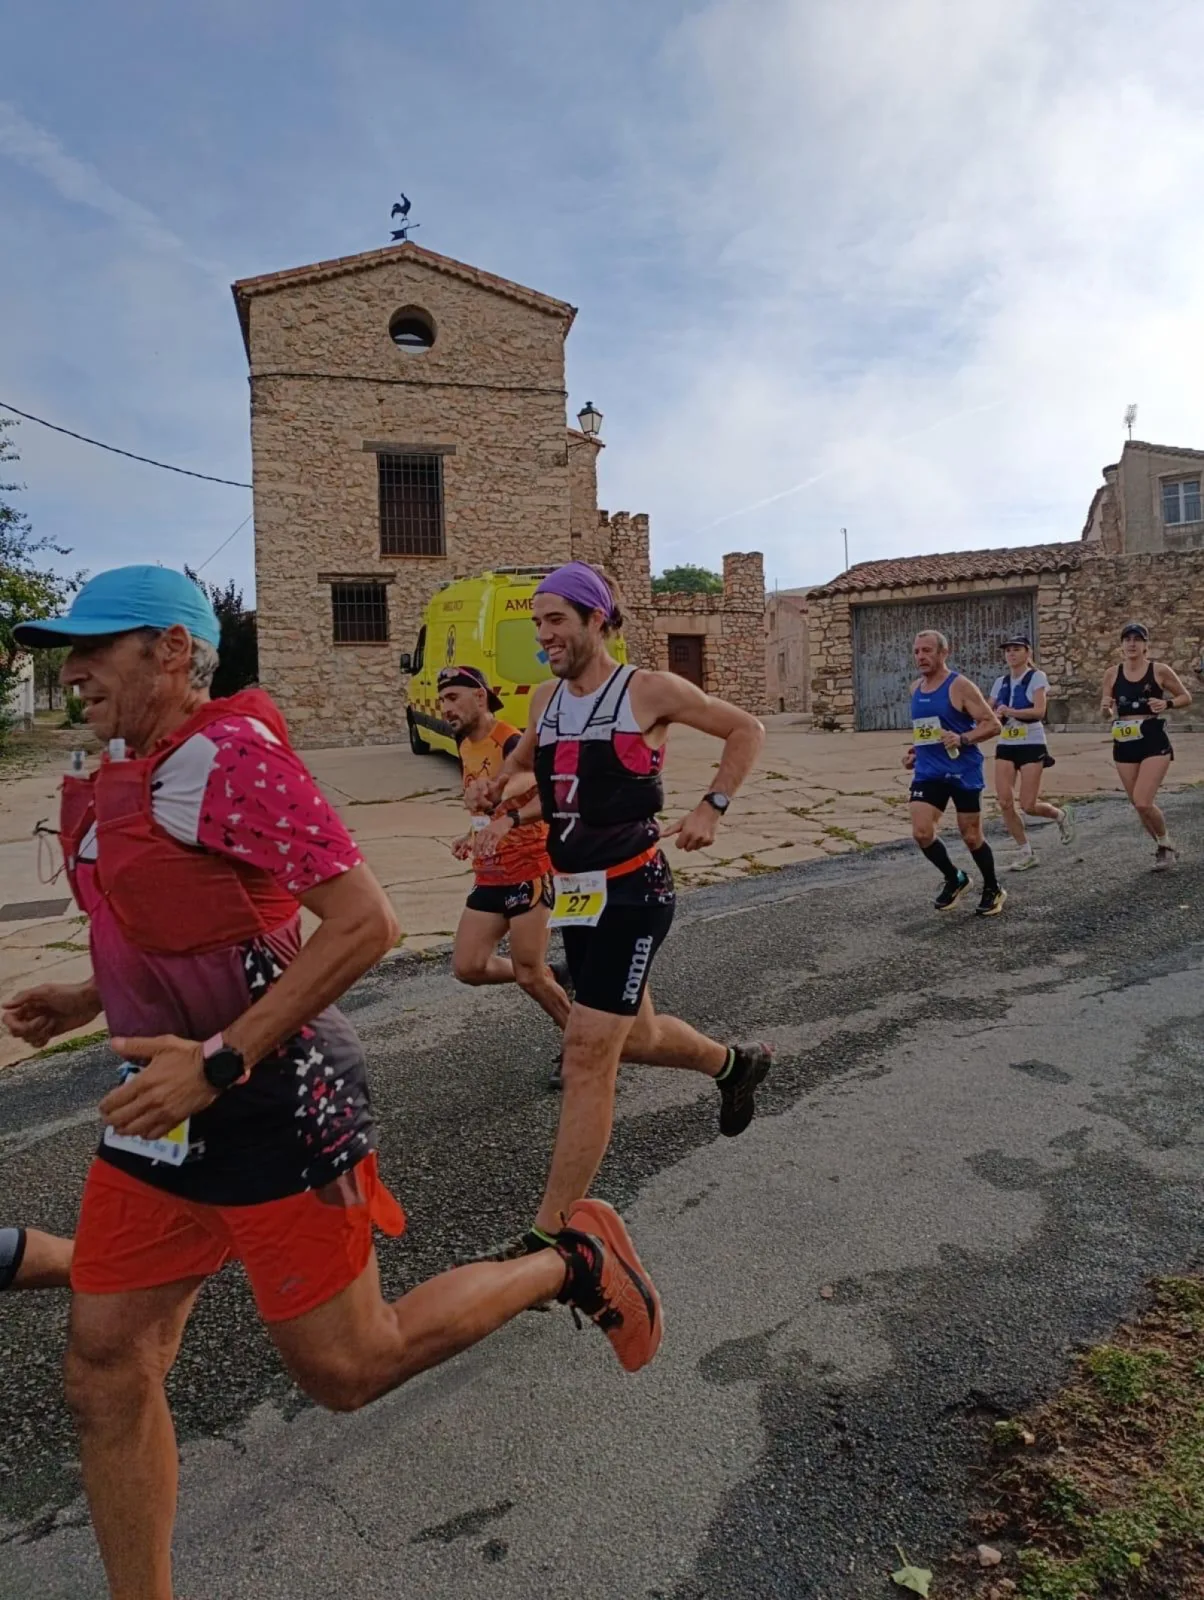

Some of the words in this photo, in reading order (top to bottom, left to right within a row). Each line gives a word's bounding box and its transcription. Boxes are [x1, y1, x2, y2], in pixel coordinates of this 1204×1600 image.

[919, 728, 932, 738] 25
[1008, 728, 1020, 737] 19
[1120, 726, 1132, 737] 10
[566, 895, 591, 913] 27
